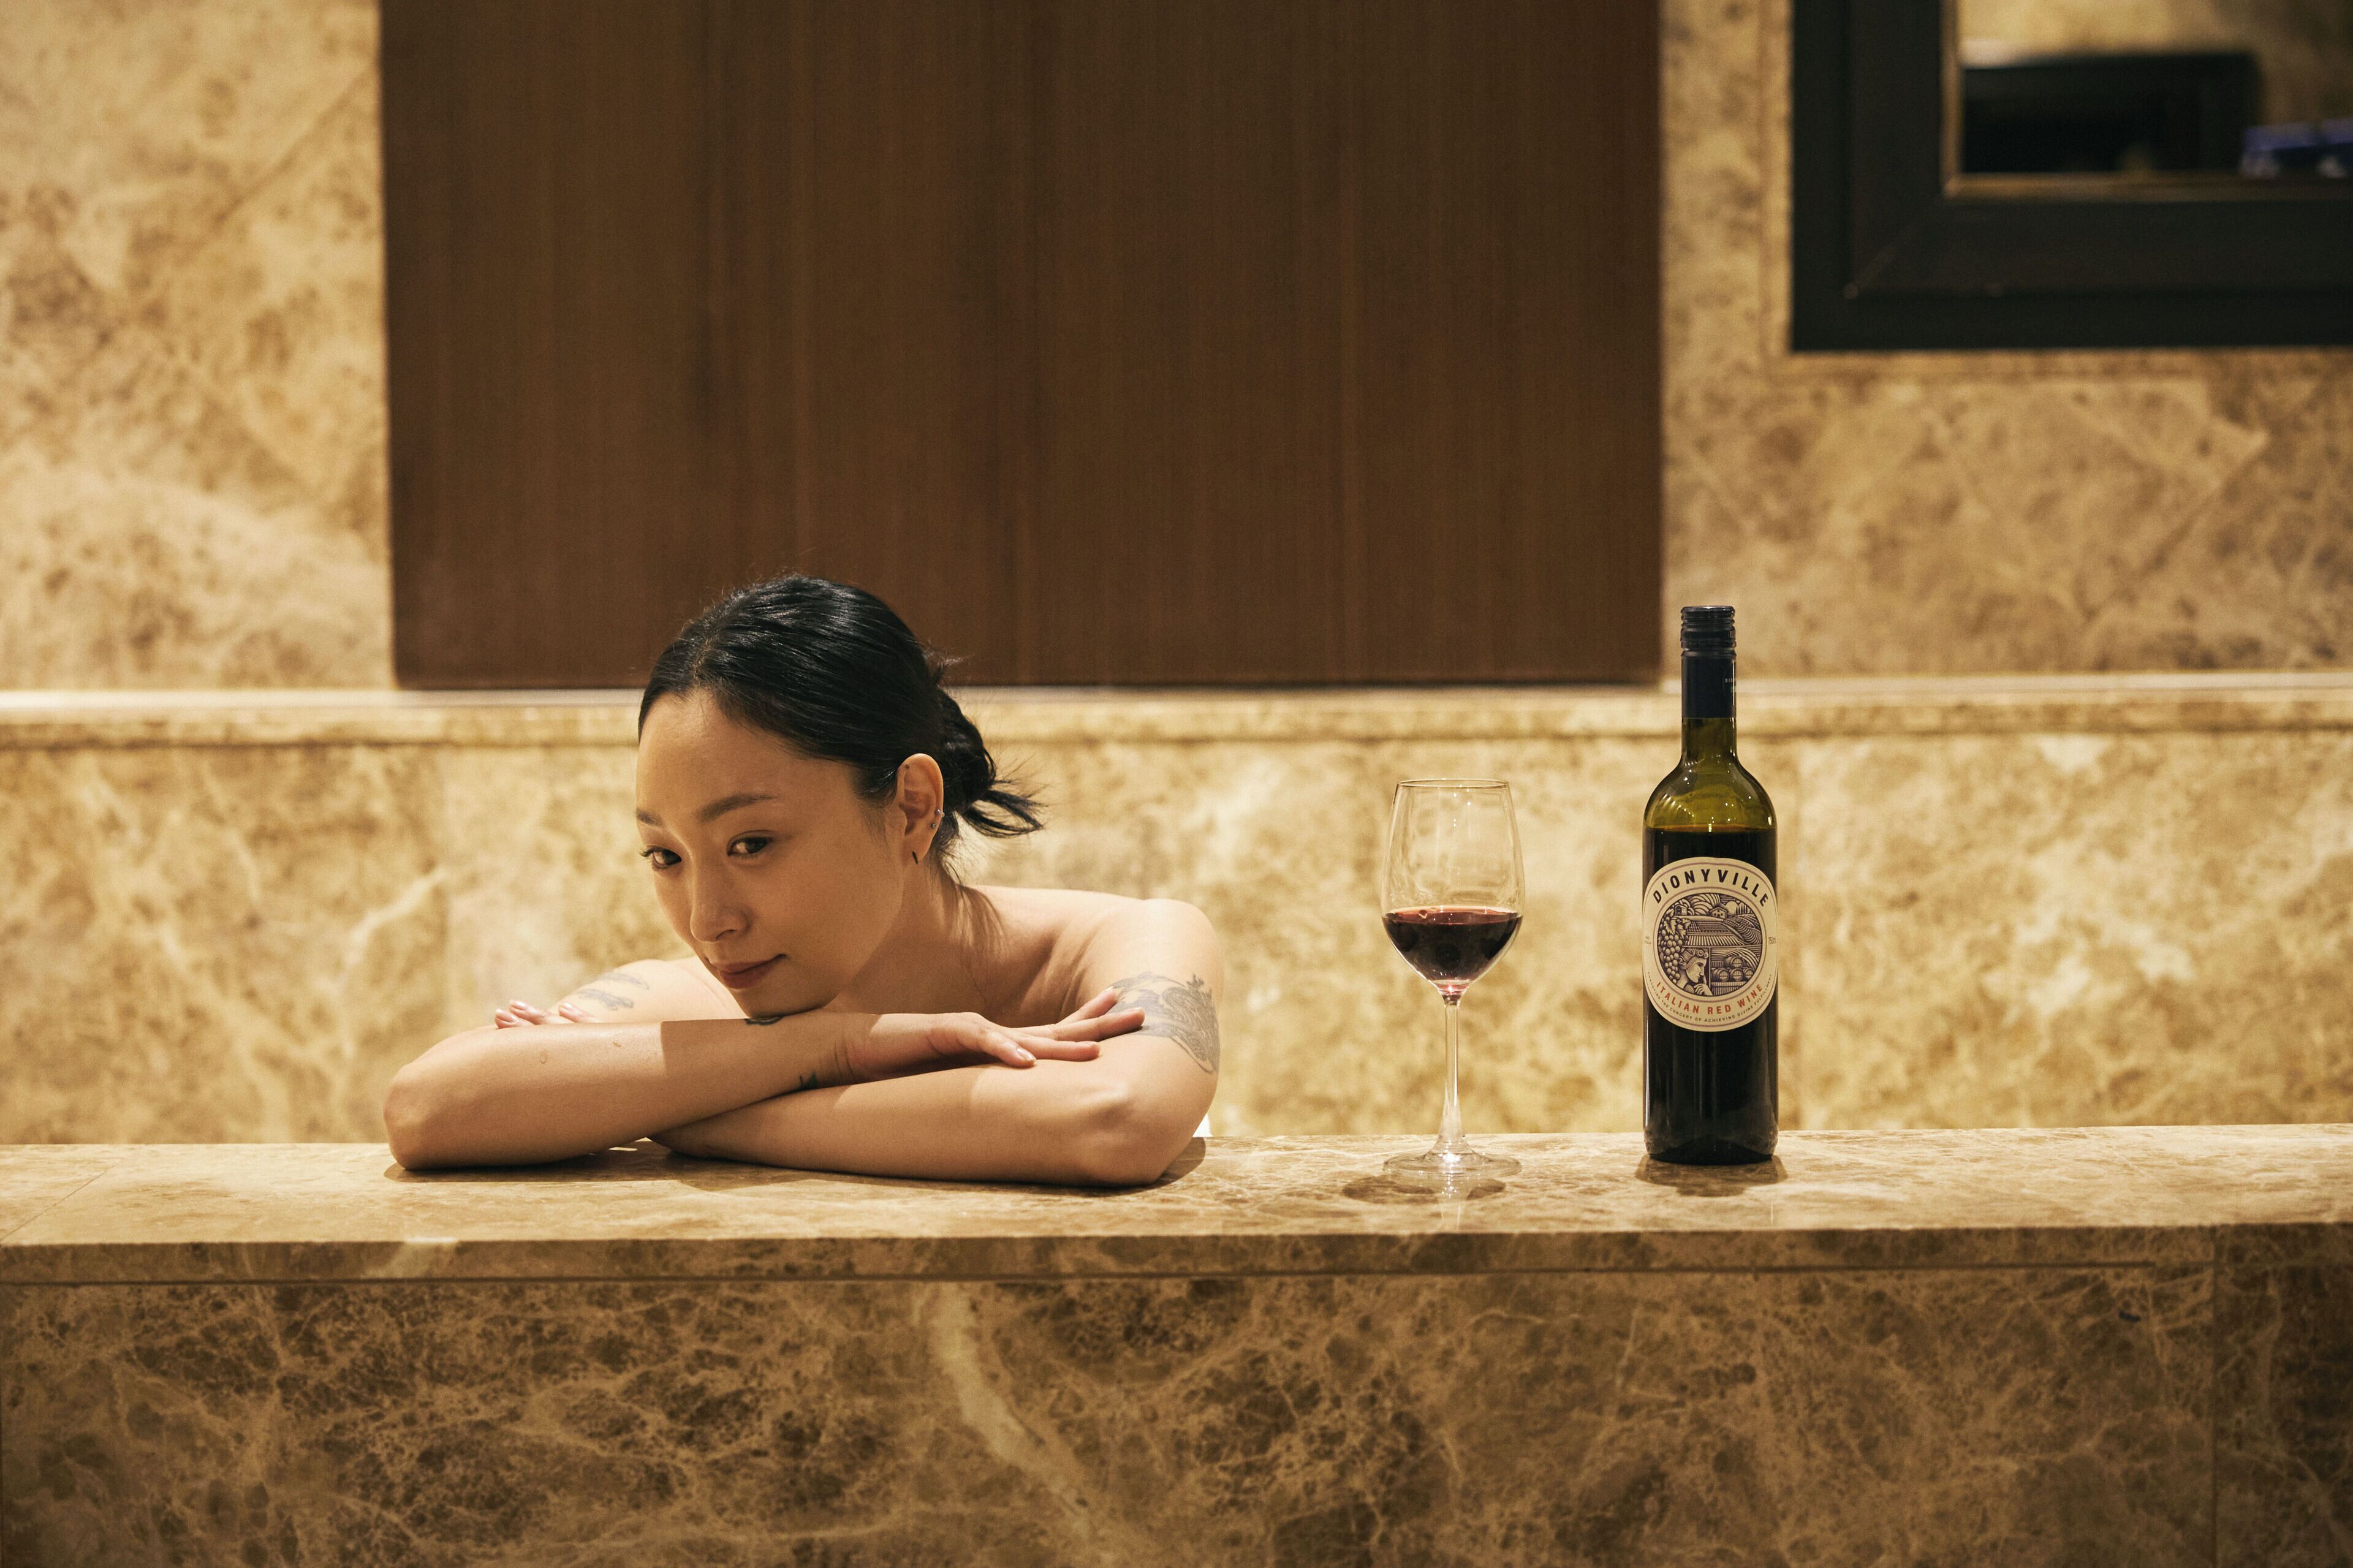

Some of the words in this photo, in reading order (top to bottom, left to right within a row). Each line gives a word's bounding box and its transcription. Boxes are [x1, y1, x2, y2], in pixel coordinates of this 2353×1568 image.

[1653, 869, 1768, 907] DIONYVILLE
[1656, 982, 1699, 1014] ITALIAN
[1707, 1004, 1731, 1015] RED
[1737, 983, 1762, 1008] WINE
[1670, 1007, 1692, 1019] CONCEPT
[1737, 1006, 1753, 1017] DIVINE
